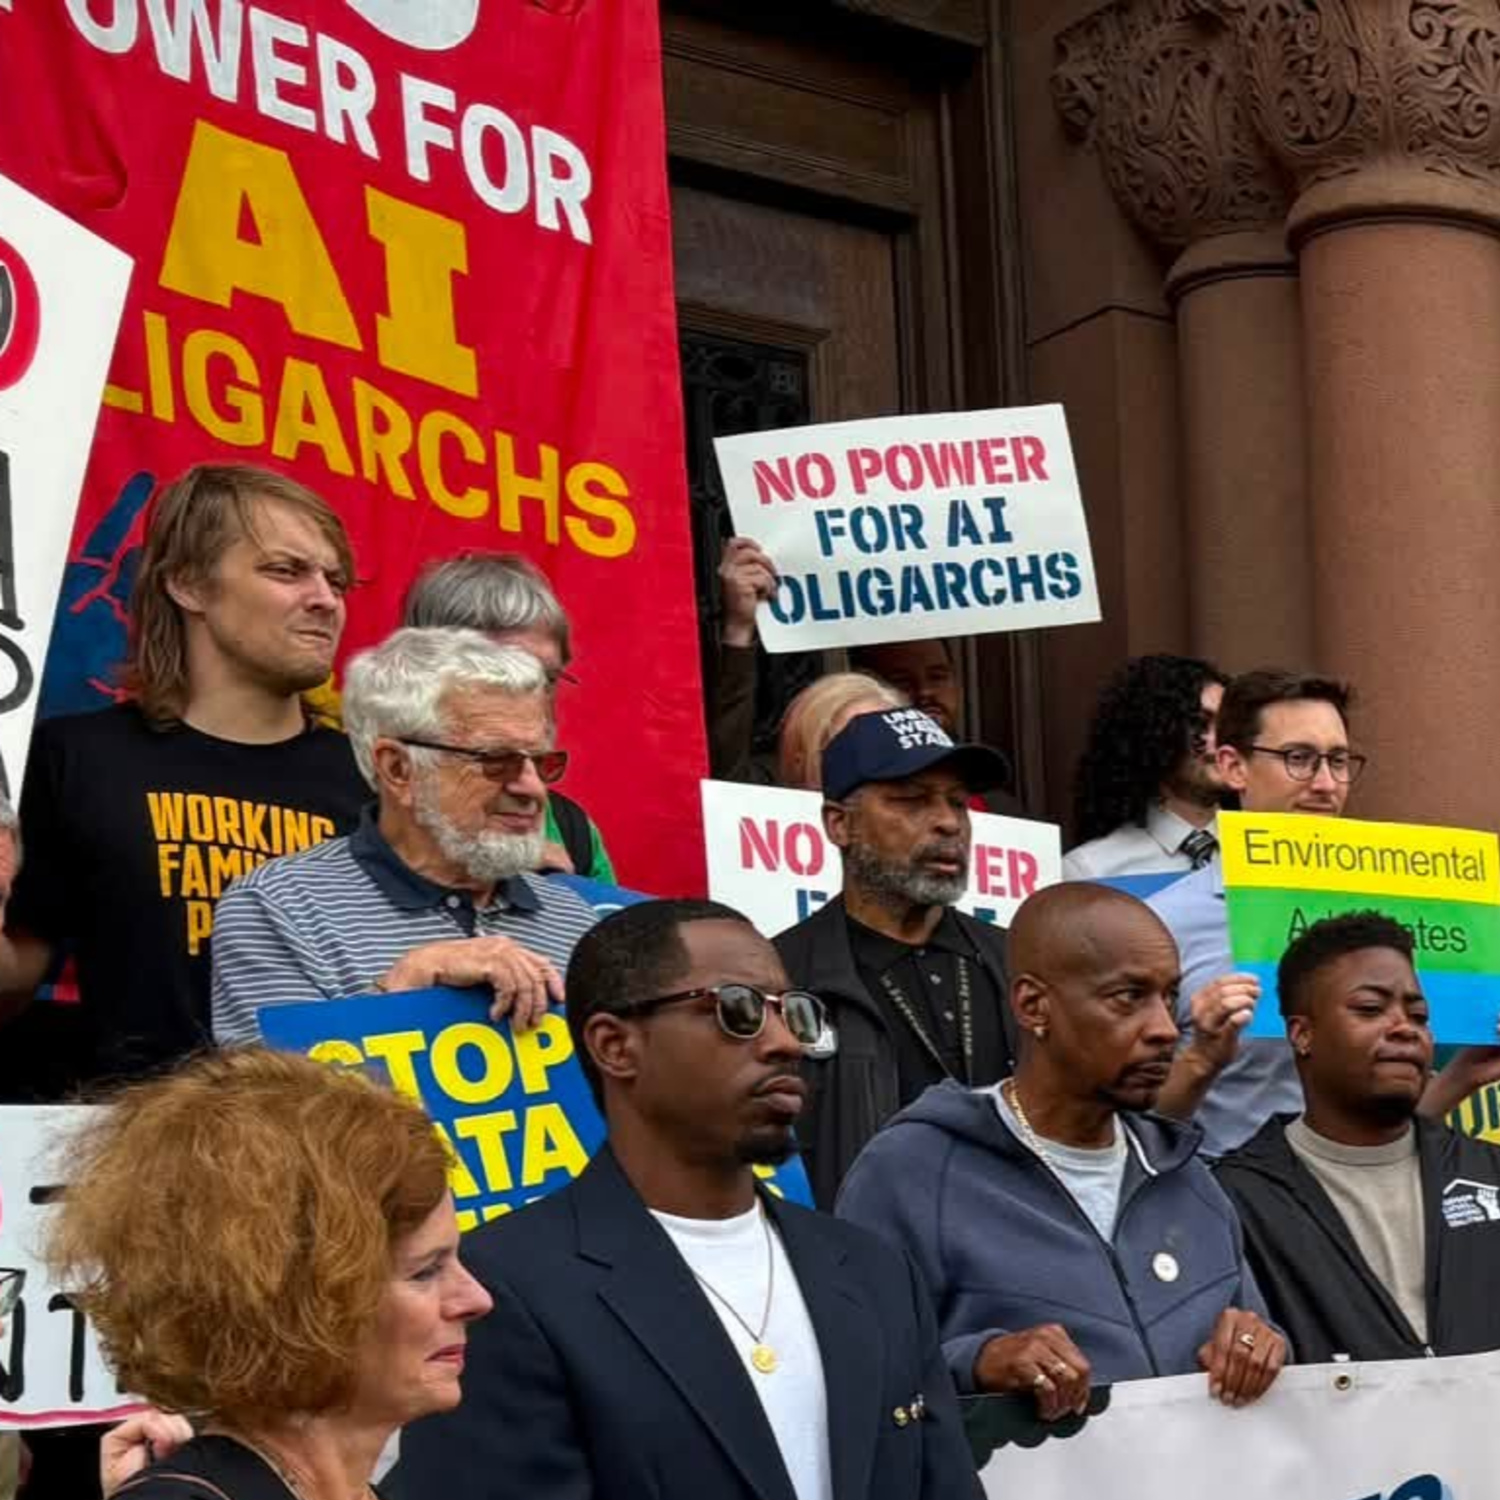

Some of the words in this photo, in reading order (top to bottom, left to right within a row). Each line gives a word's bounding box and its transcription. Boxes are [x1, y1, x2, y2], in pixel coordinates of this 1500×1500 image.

[400, 71, 593, 244] FOR
[158, 118, 479, 398] AI
[102, 310, 637, 557] IGARCHS
[752, 453, 836, 505] NO
[846, 435, 1050, 495] POWER
[814, 503, 925, 556] FOR
[947, 497, 1012, 547] AI
[772, 552, 1083, 625] OLIGARCHS
[739, 816, 825, 876] NO
[1244, 828, 1486, 882] Environmental
